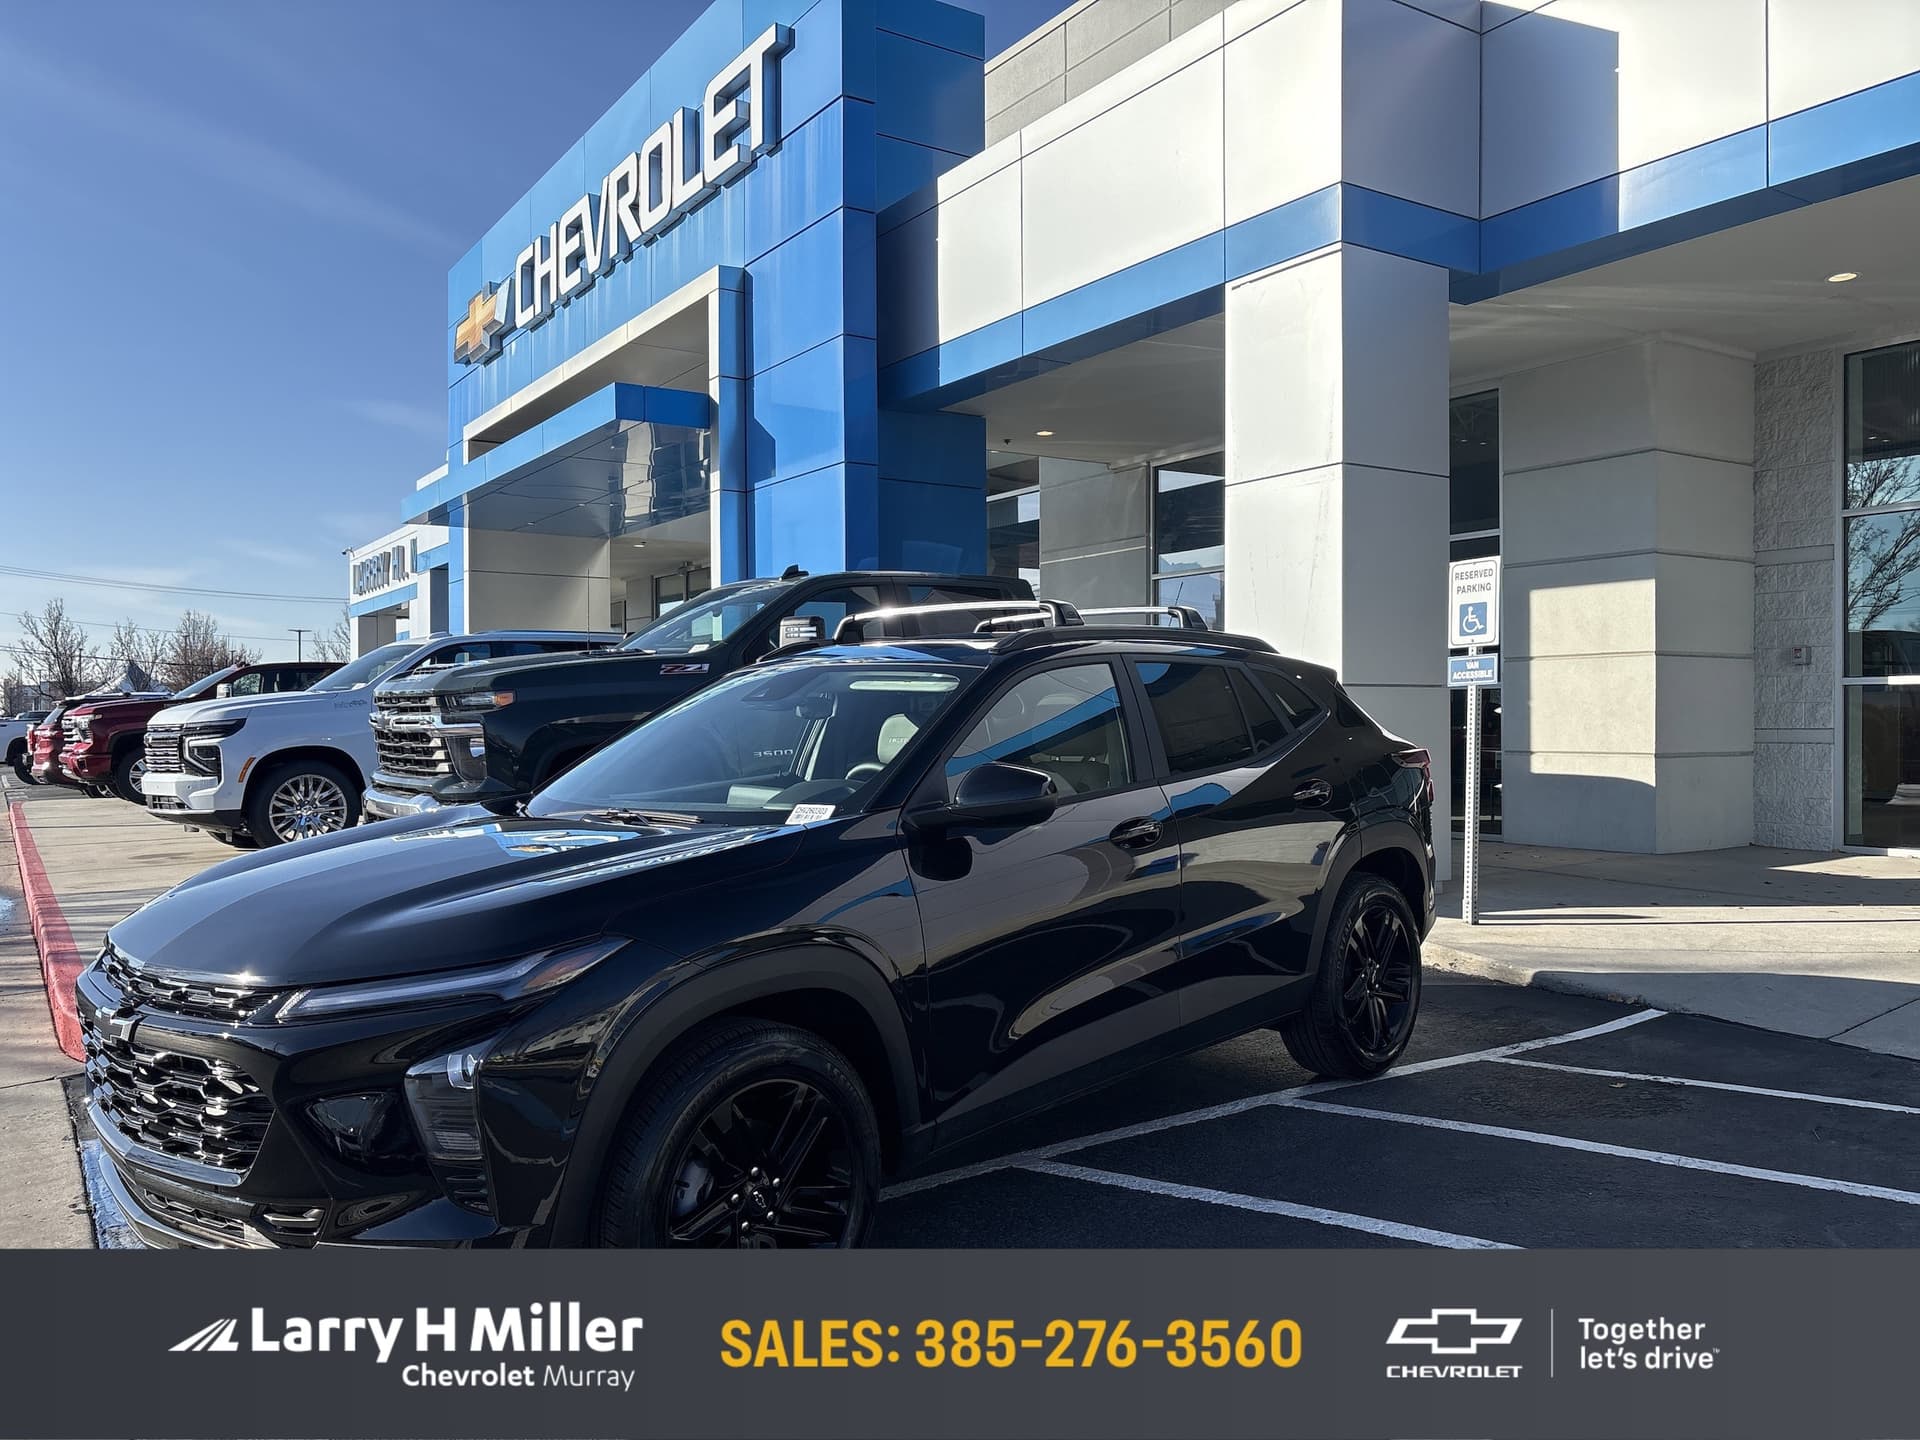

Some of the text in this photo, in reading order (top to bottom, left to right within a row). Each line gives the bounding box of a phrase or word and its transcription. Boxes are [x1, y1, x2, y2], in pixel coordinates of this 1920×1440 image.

[515, 22, 790, 329] CHEVROLET
[1455, 568, 1494, 581] RESERVED
[1457, 582, 1492, 594] PARKING
[660, 663, 710, 675] Z71
[1465, 660, 1480, 670] VAN
[1452, 669, 1493, 680] ACCESSIBLE
